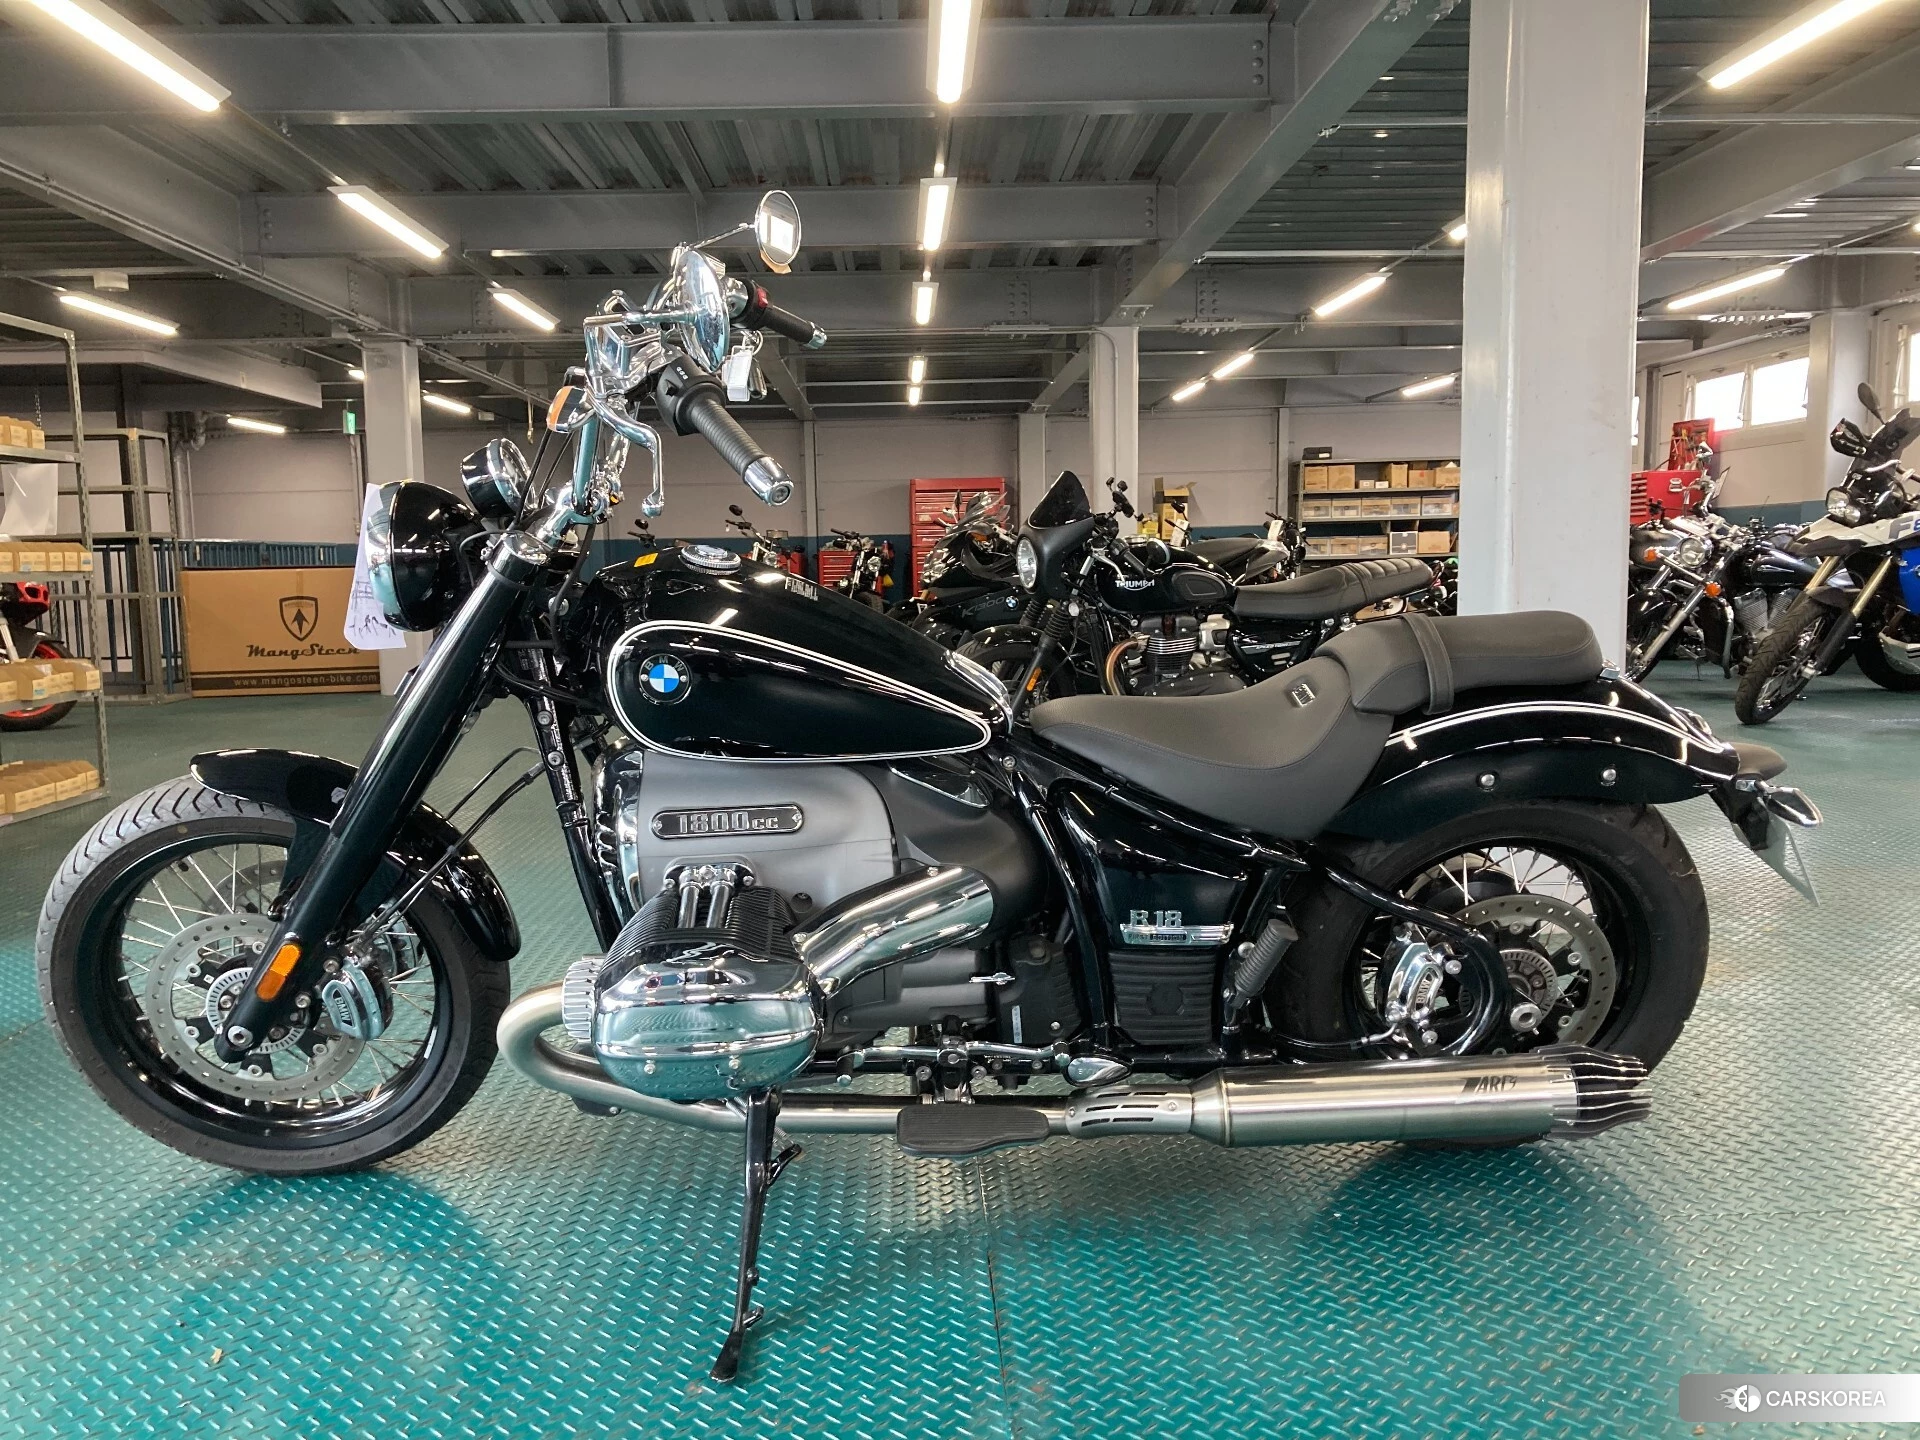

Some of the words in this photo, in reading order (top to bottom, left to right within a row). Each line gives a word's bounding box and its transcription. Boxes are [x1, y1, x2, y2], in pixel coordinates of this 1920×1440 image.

[644, 655, 685, 672] BMW
[234, 673, 377, 686] www.mangosteen-bike.com
[676, 811, 779, 834] 1800cc
[1130, 909, 1150, 927] R
[1154, 909, 1182, 928] 18
[1415, 978, 1432, 1004] BMW
[334, 996, 352, 1021] BMW
